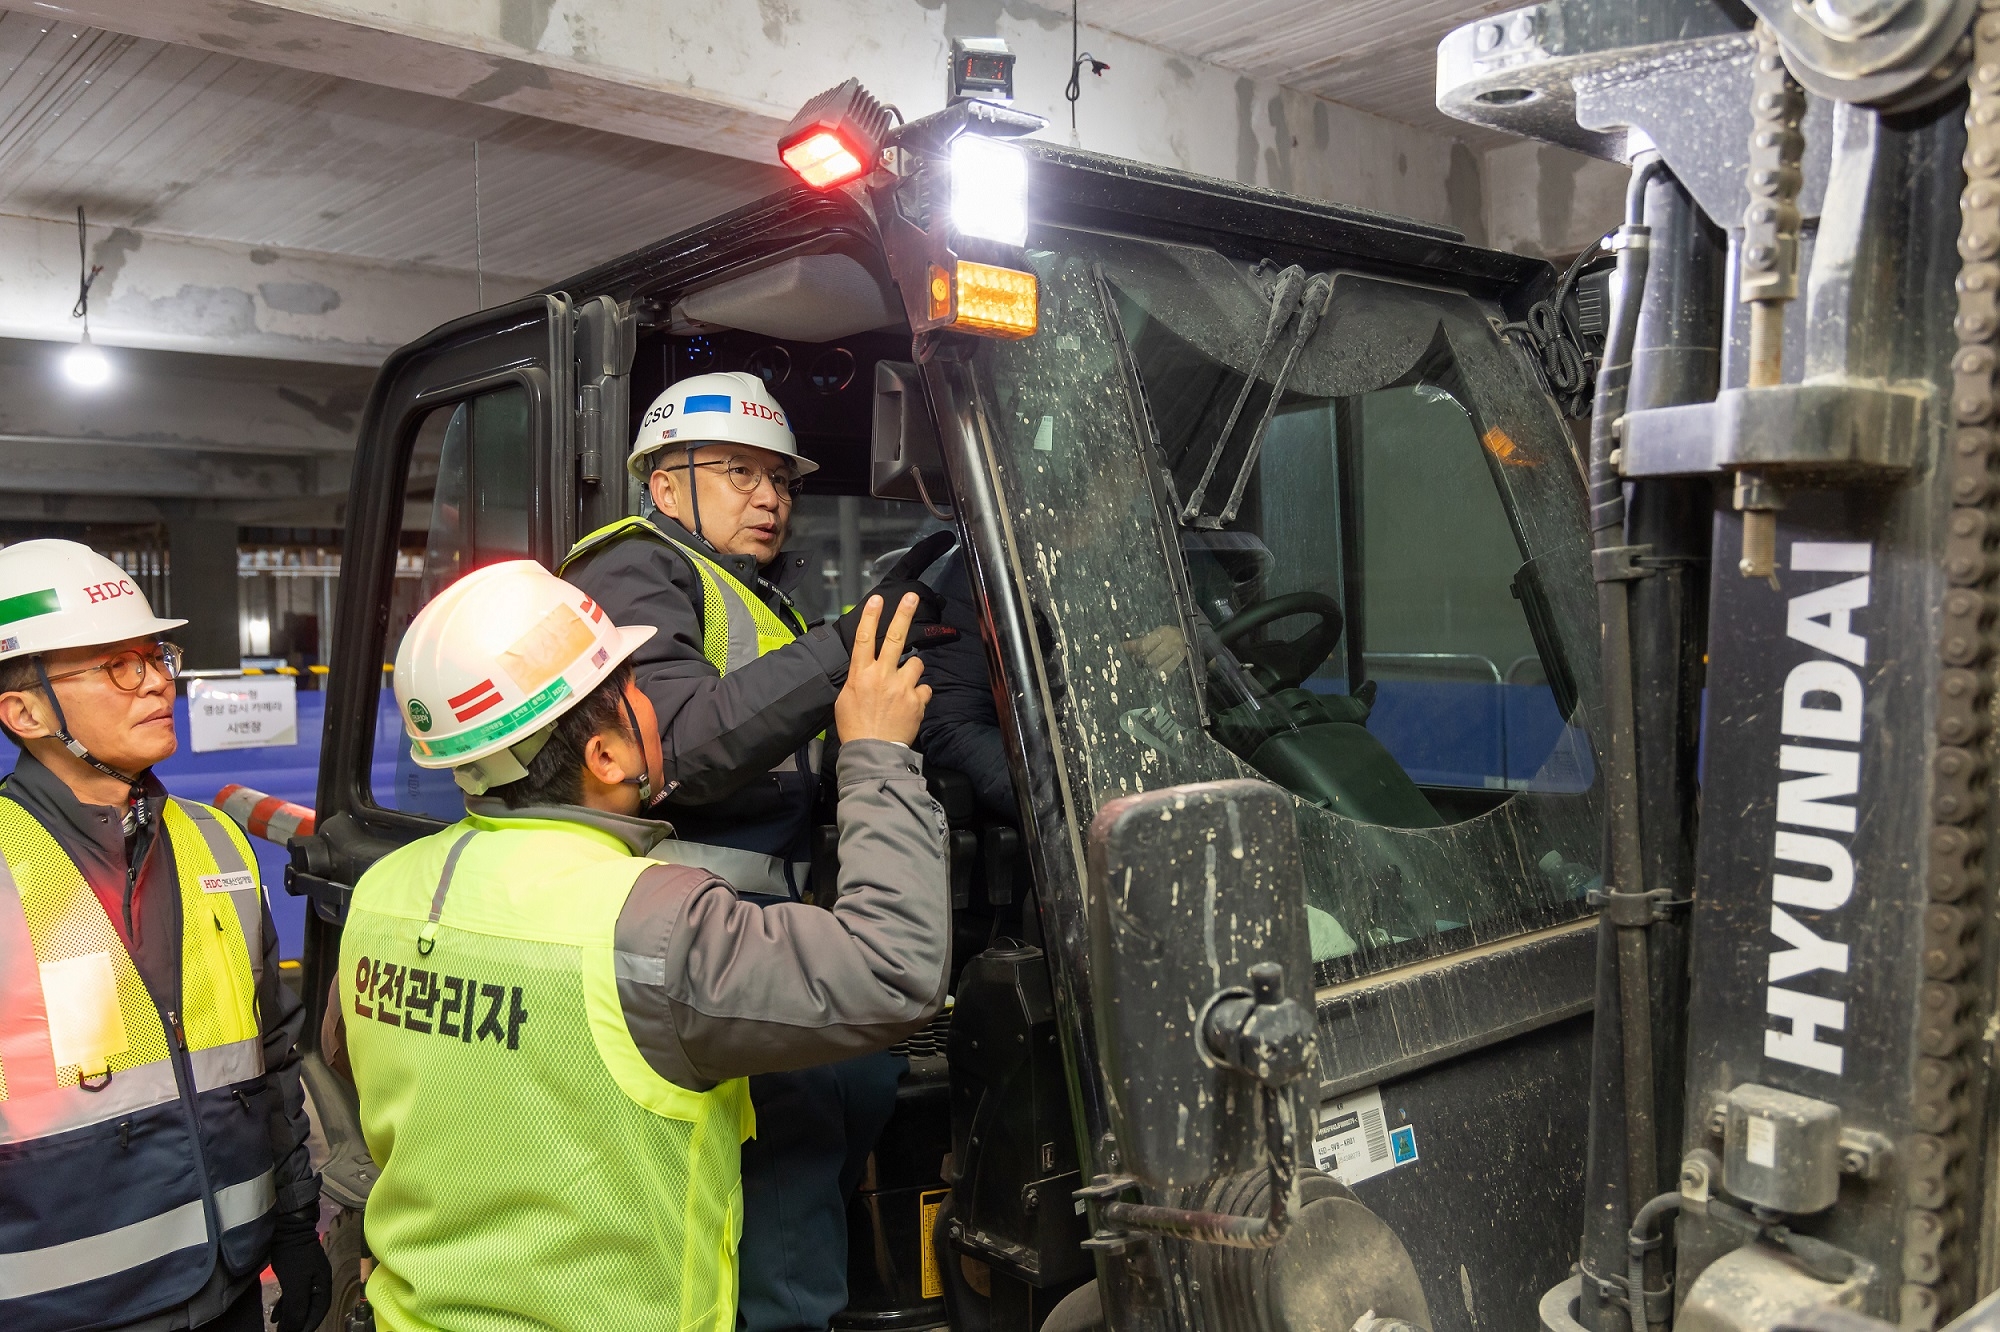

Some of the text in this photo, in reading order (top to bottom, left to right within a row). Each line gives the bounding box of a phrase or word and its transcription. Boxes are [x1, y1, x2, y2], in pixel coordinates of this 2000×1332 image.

[644, 403, 675, 428] CSO
[740, 400, 784, 427] HDC
[83, 579, 134, 604] HDC
[1763, 541, 1873, 1076] HYUNDAI
[204, 878, 223, 889] HDC
[355, 955, 529, 1051] 안전관리자
